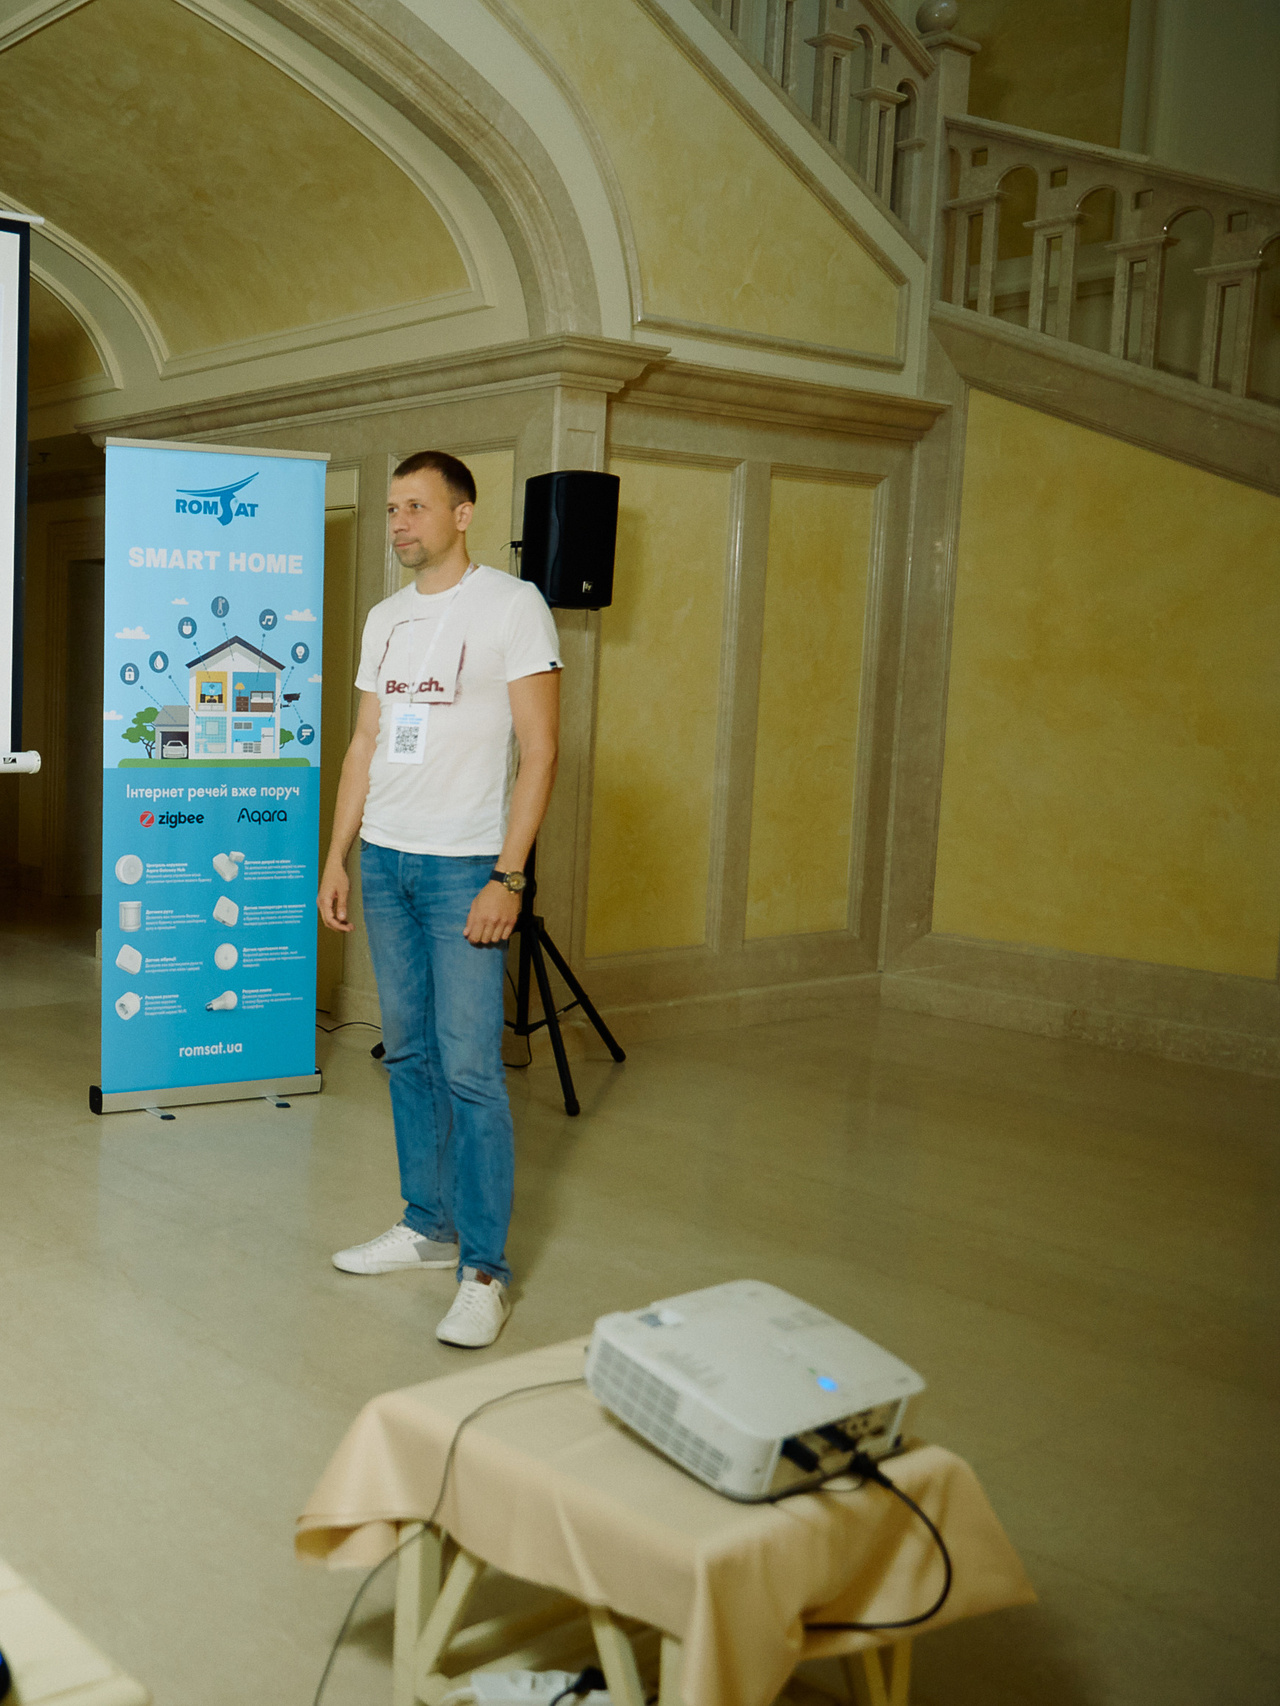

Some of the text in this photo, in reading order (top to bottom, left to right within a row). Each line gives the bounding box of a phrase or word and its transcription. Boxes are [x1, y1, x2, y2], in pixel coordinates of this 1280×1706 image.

[175, 493, 259, 526] ROMSAT
[128, 546, 304, 575] SMART HOME
[385, 677, 445, 694] Bech.
[126, 784, 300, 802] Інтернет речей вже поруч
[158, 811, 205, 829] zigbee
[237, 807, 288, 825] Aqara
[178, 1041, 243, 1057] romsat.ua
